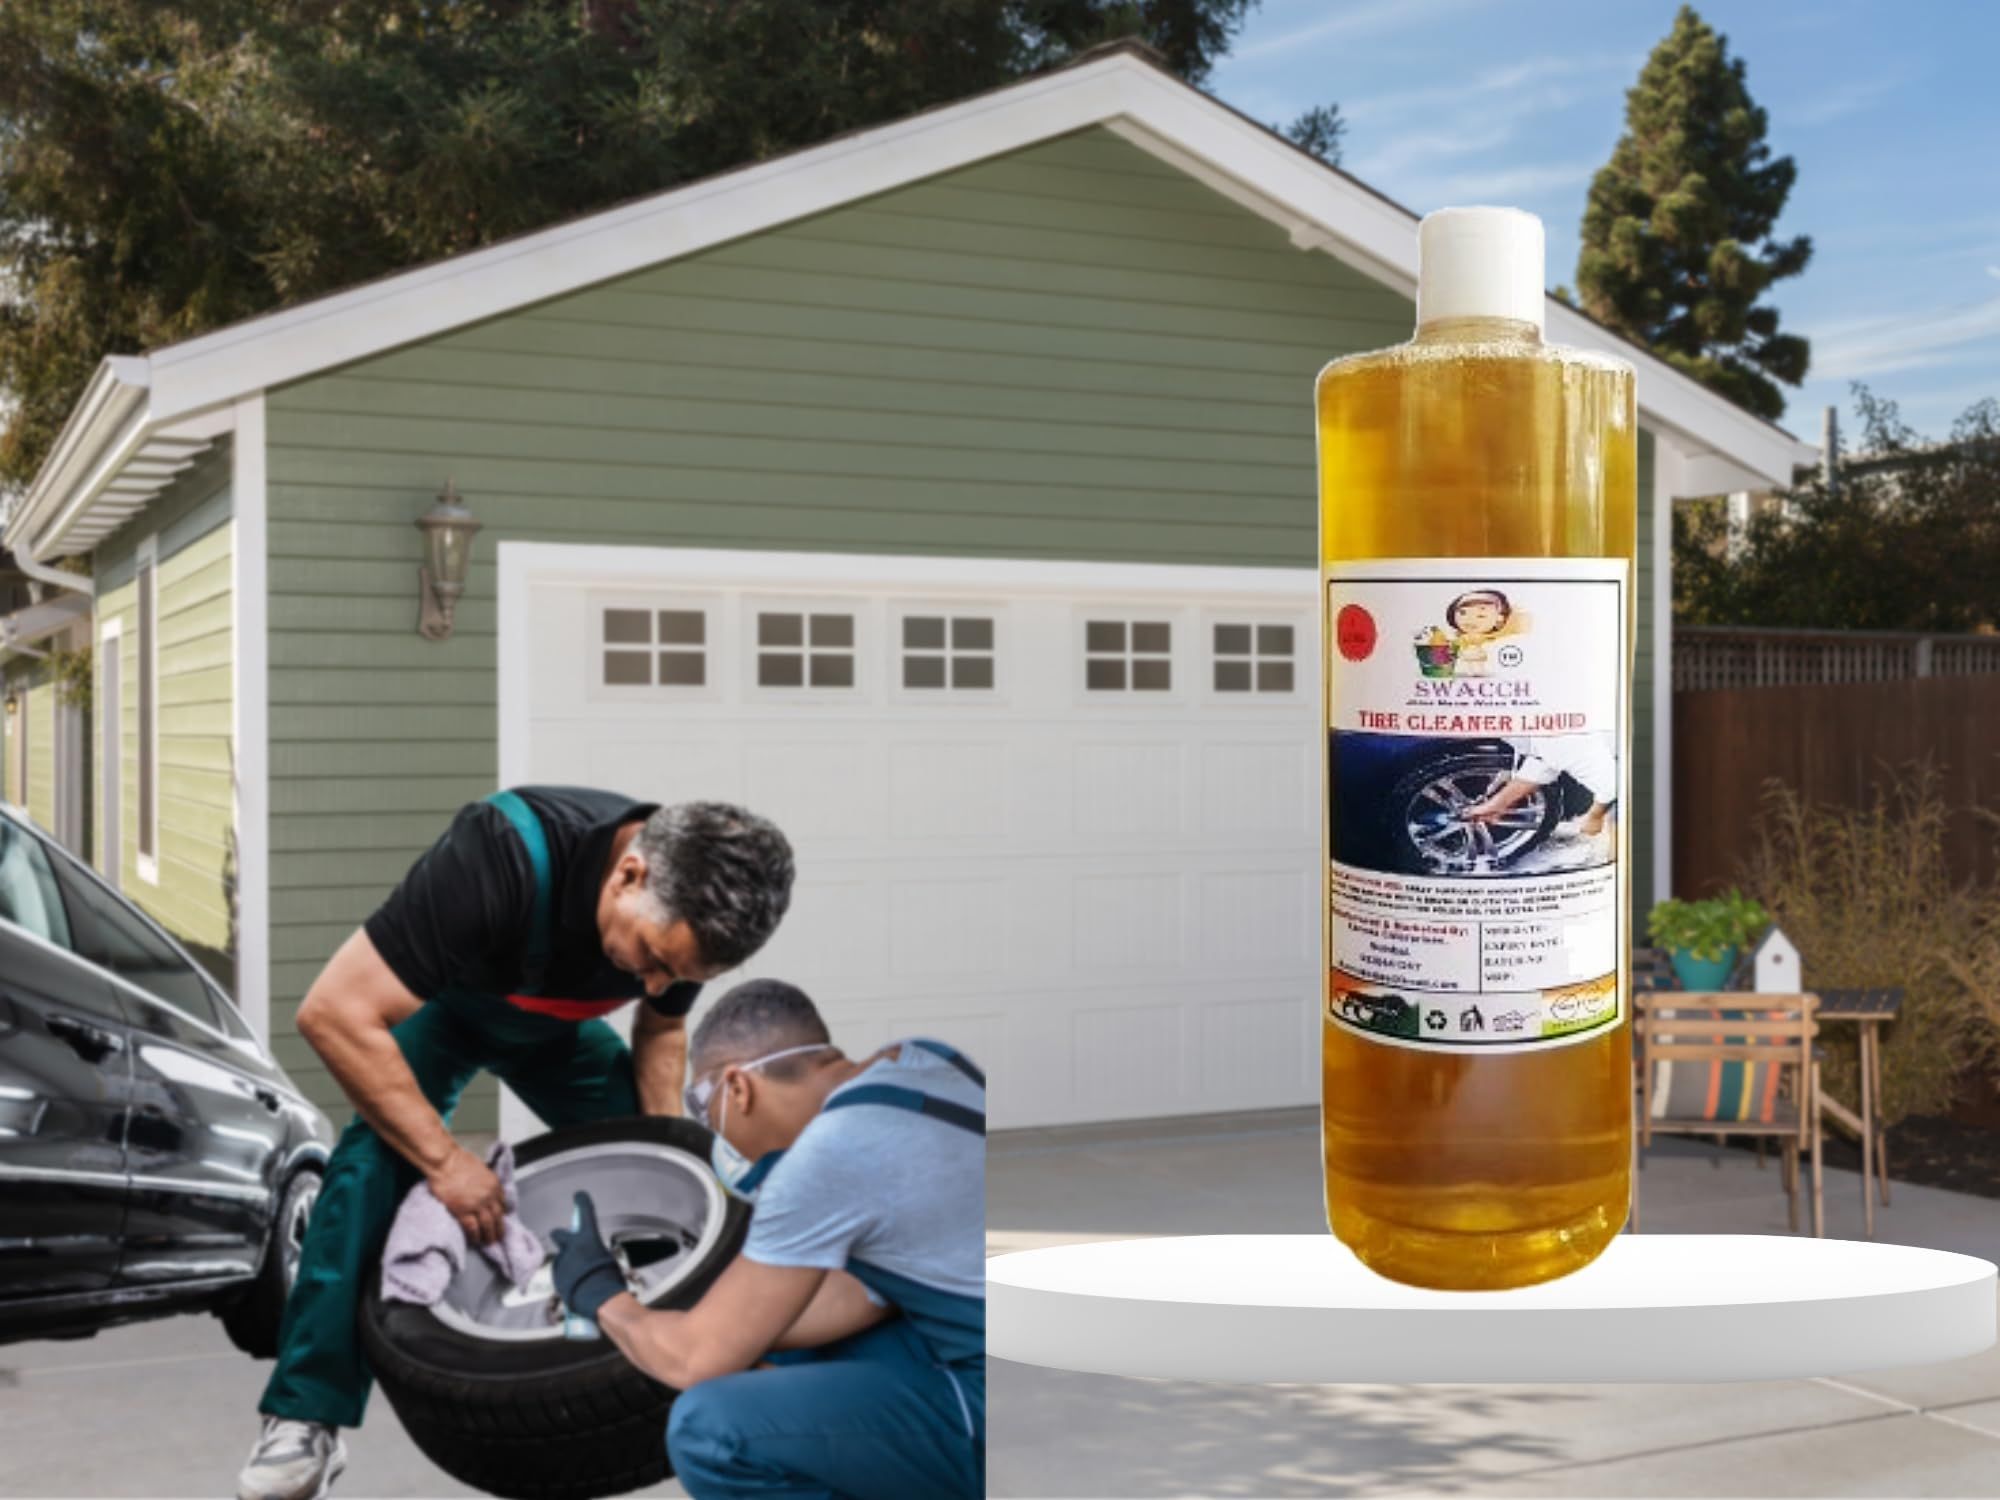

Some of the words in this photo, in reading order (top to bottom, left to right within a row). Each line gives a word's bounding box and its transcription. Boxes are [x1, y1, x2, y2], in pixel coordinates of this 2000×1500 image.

[1415, 680, 1530, 698] SWACCH
[1359, 710, 1399, 730] TIRE
[1408, 715, 1513, 731] CLEANER
[1522, 712, 1587, 731] LIQUID
